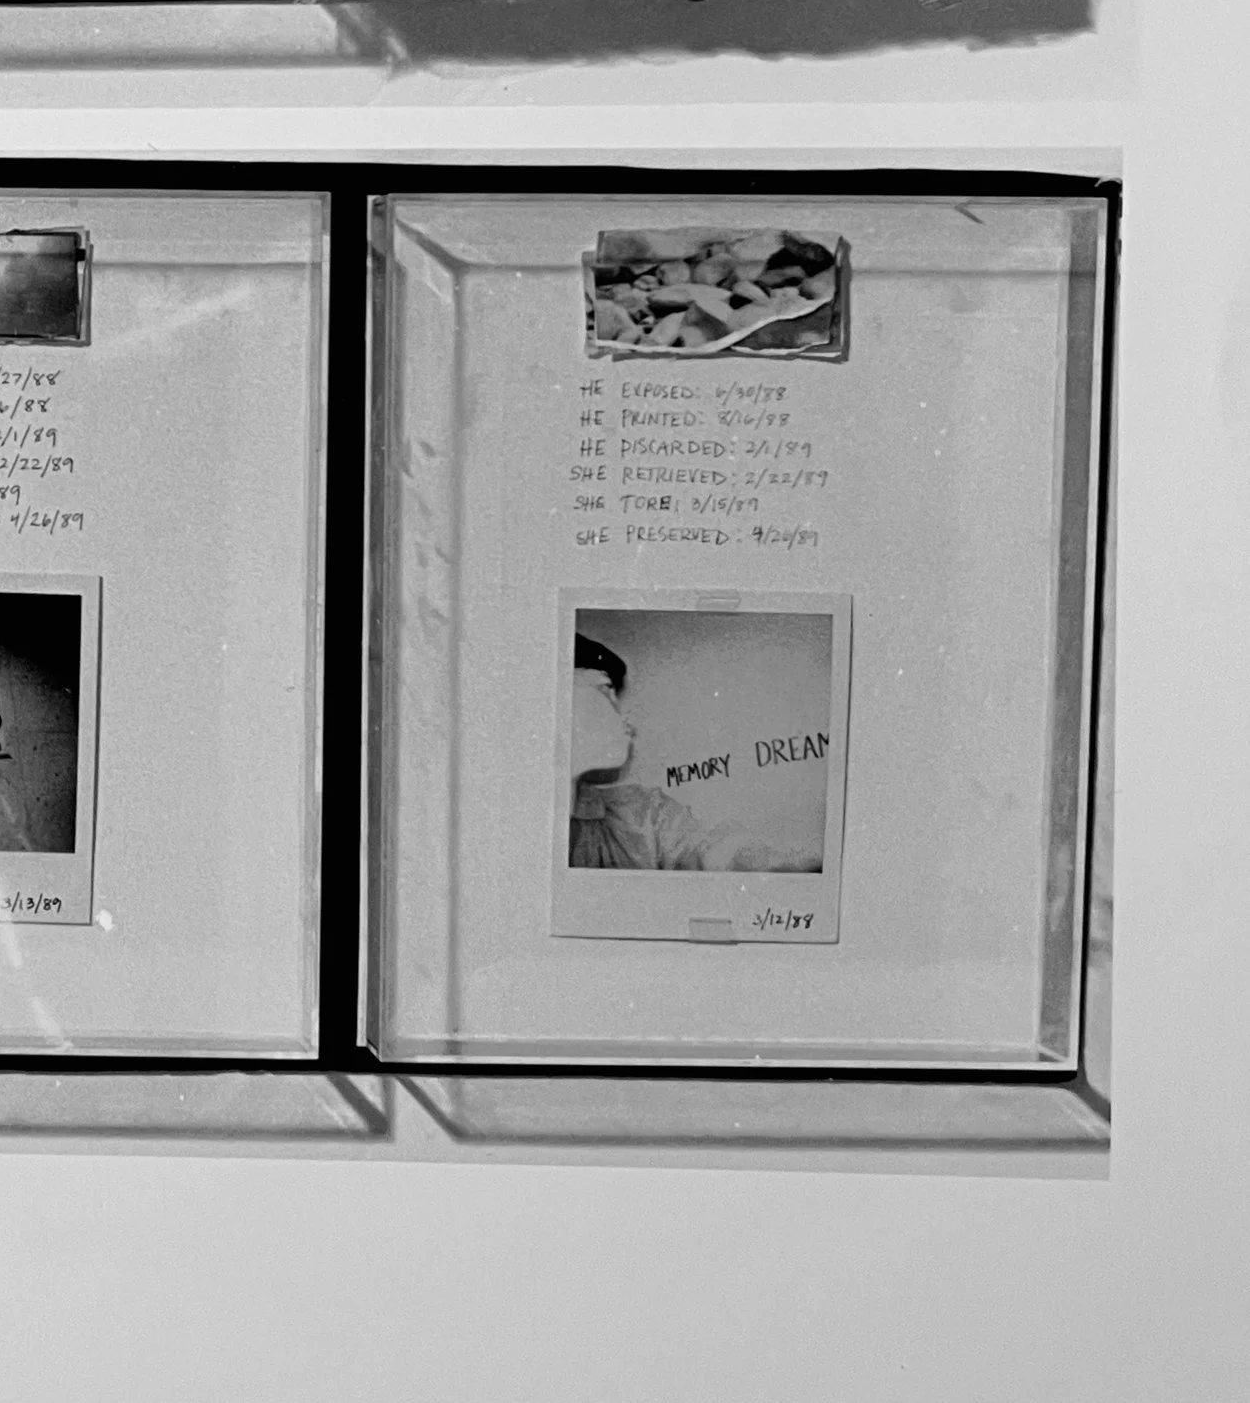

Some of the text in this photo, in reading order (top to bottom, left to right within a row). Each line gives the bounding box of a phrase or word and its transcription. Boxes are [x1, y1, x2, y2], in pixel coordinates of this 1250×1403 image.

[579, 378, 604, 397] HE
[580, 409, 605, 427] HE
[621, 409, 705, 428] PRINTED:
[580, 437, 813, 459] HE DISCARDED: 2/1/89
[0, 453, 74, 479] 2/22/89
[568, 465, 607, 481] SHE
[622, 465, 737, 486] RETRIEVED:
[573, 495, 605, 511] SHE
[691, 493, 759, 515] 3/15/89
[10, 505, 85, 535] 4/26/89
[576, 526, 610, 546] SHE
[626, 524, 742, 546] PRESERVED:
[667, 753, 730, 788] MEMORY
[0, 891, 62, 914] 3/13/89
[752, 907, 814, 931] 3/12/88
